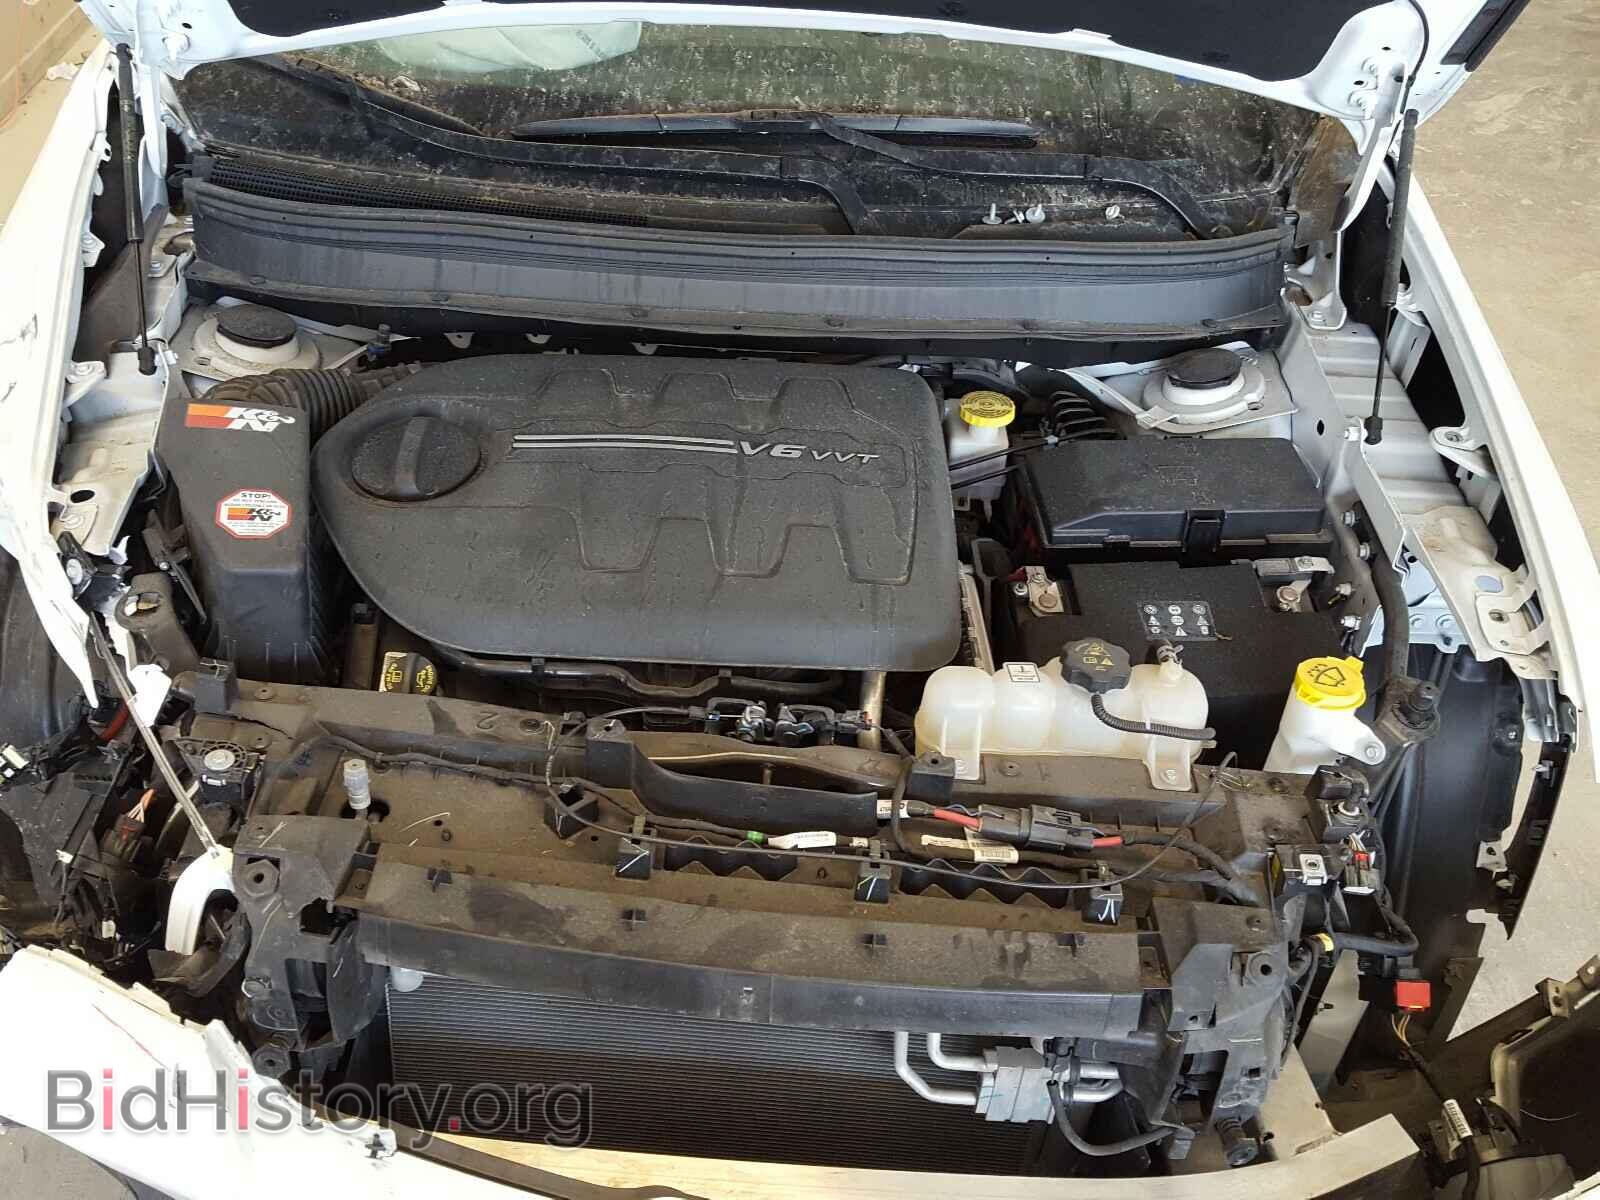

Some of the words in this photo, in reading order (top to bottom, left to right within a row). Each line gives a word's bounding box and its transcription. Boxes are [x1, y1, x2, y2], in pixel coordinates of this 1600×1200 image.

[224, 406, 295, 432] K&N
[739, 441, 807, 458] V6
[811, 449, 880, 463] VVT
